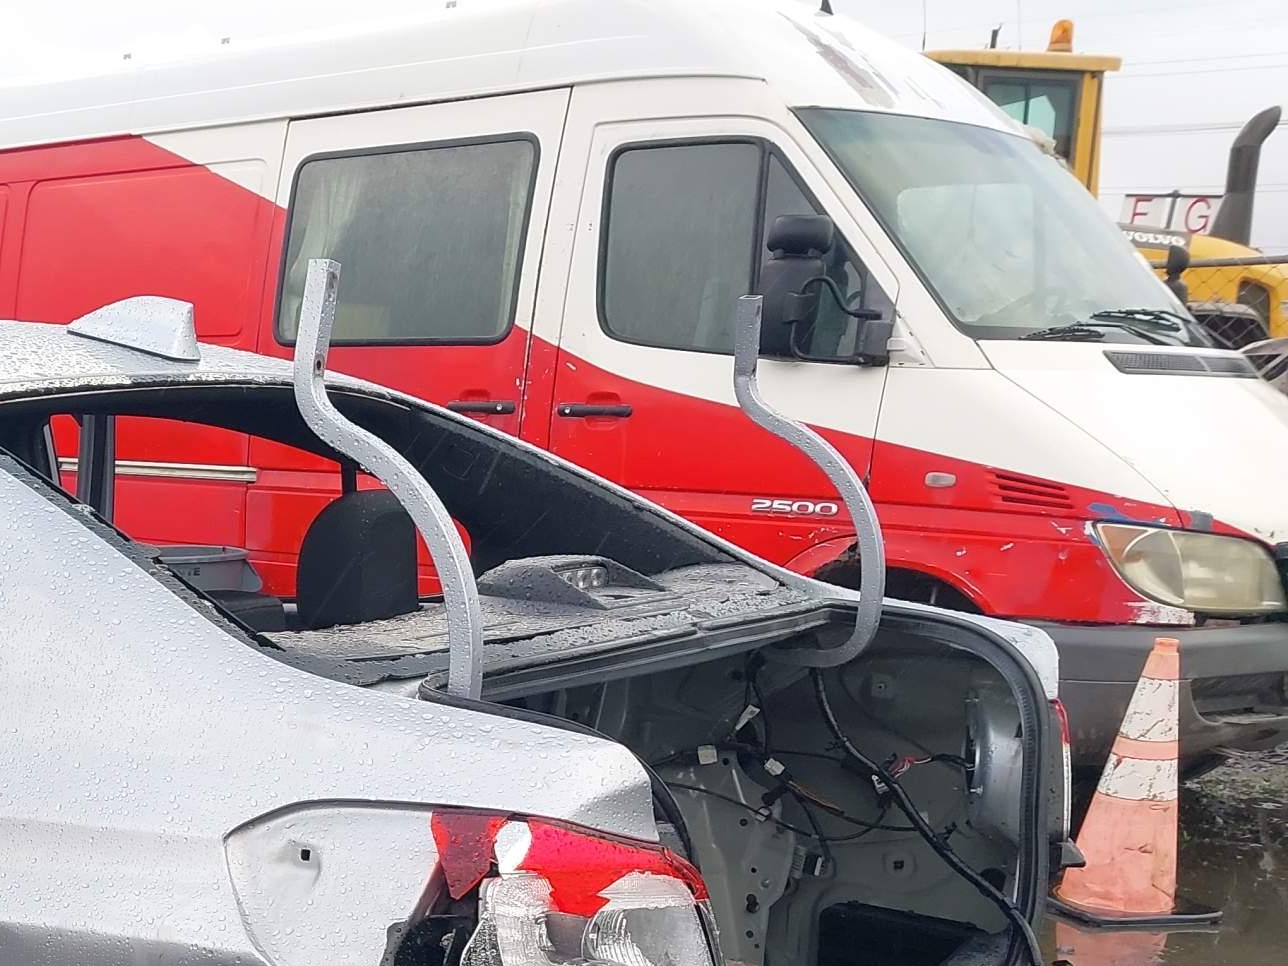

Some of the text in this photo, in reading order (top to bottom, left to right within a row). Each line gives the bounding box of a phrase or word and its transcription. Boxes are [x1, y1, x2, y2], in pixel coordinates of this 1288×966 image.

[1184, 196, 1212, 234] G
[1122, 230, 1187, 247] VOLVO
[751, 498, 839, 516] 2500
